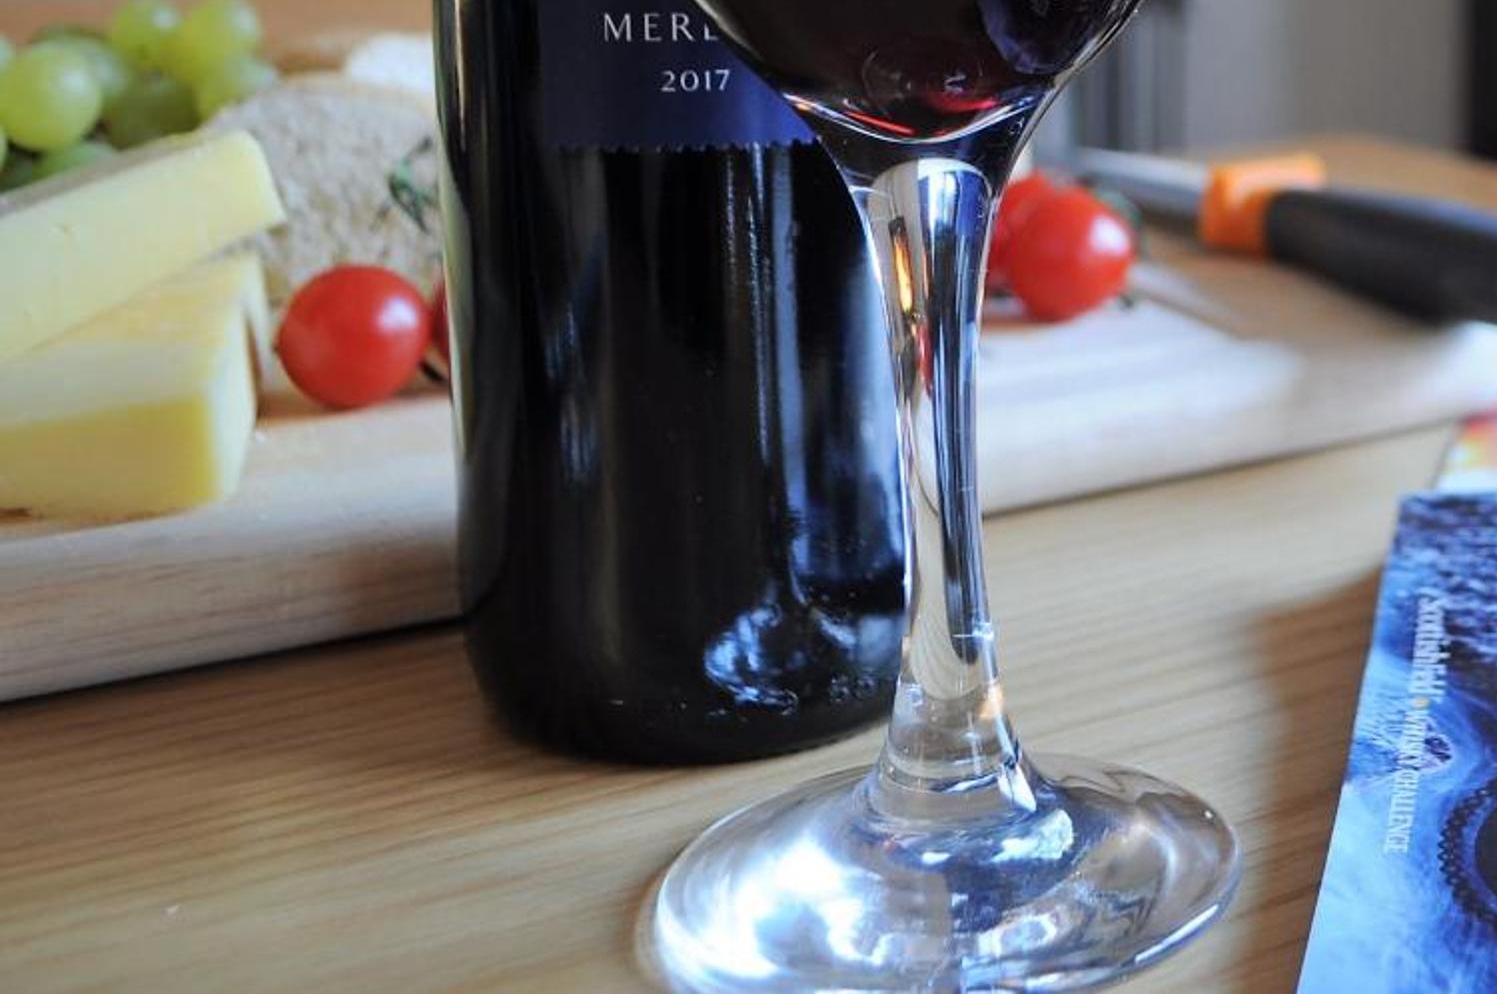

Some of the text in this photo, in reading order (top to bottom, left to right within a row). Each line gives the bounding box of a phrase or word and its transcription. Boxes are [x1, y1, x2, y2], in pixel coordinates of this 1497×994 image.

[603, 12, 719, 42] MERL
[661, 68, 730, 92] 2017
[1383, 770, 1420, 855] CHALLENGE
